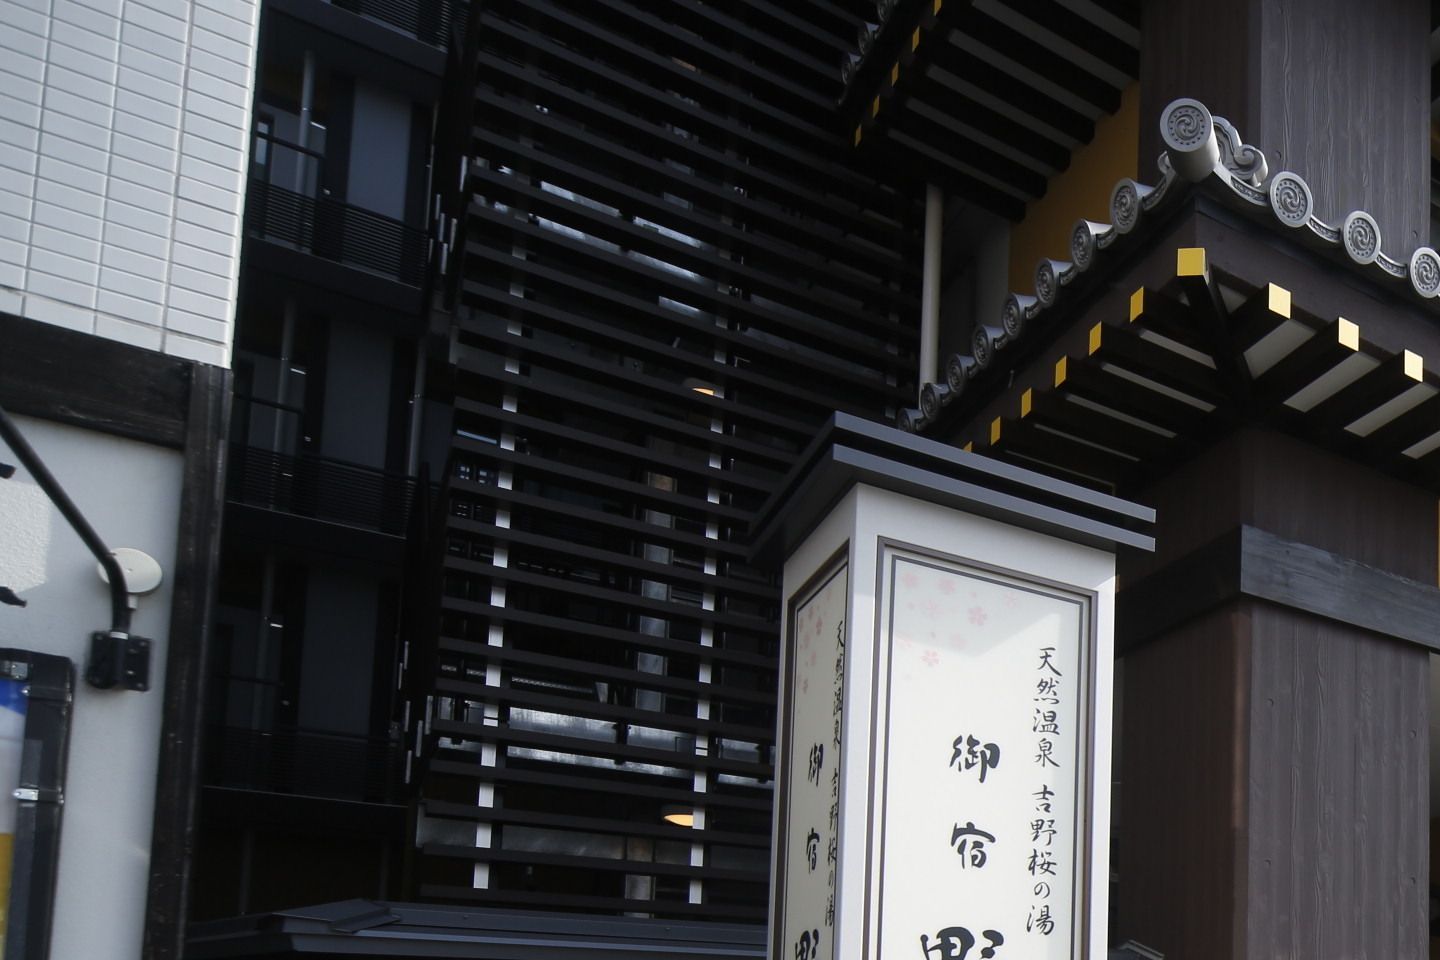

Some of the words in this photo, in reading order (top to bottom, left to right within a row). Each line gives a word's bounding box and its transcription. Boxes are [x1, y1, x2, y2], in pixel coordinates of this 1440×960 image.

[1032, 647, 1062, 767] 天然温泉
[1026, 784, 1058, 936] 吉野桜の湯
